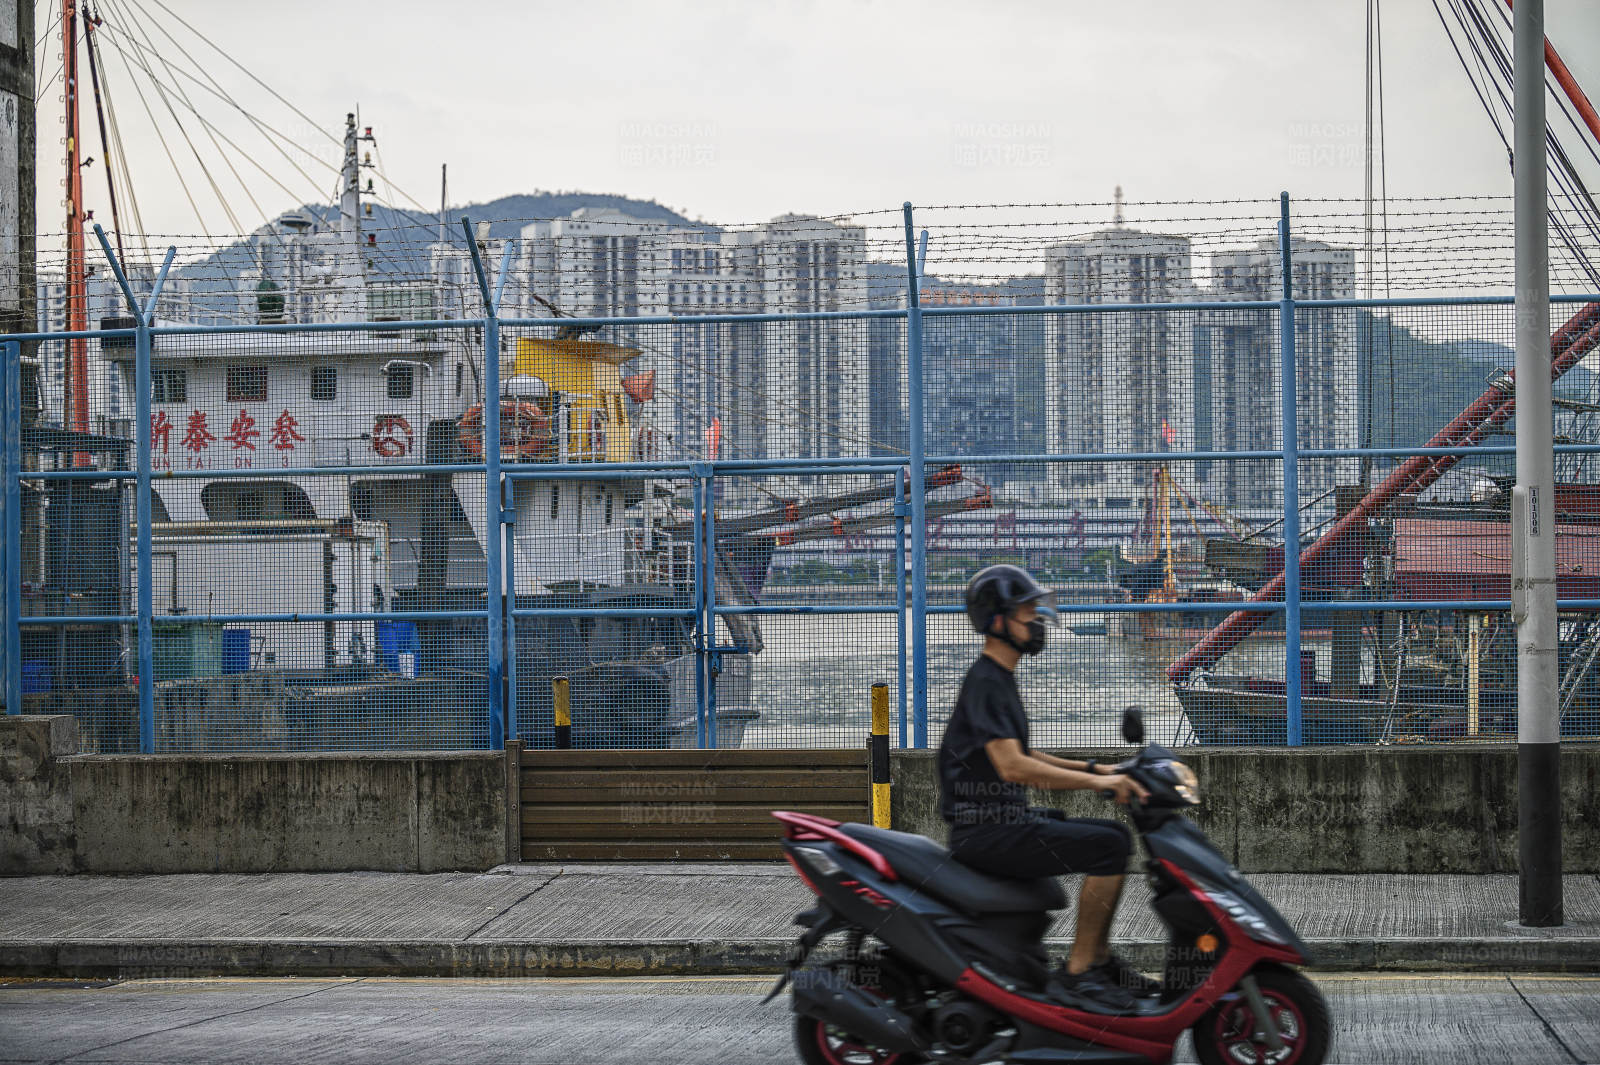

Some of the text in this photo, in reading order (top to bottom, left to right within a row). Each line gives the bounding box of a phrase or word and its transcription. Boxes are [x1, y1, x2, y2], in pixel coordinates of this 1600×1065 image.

[151, 456, 170, 470] UN
[187, 456, 212, 469] TAI
[281, 455, 289, 468] 3
